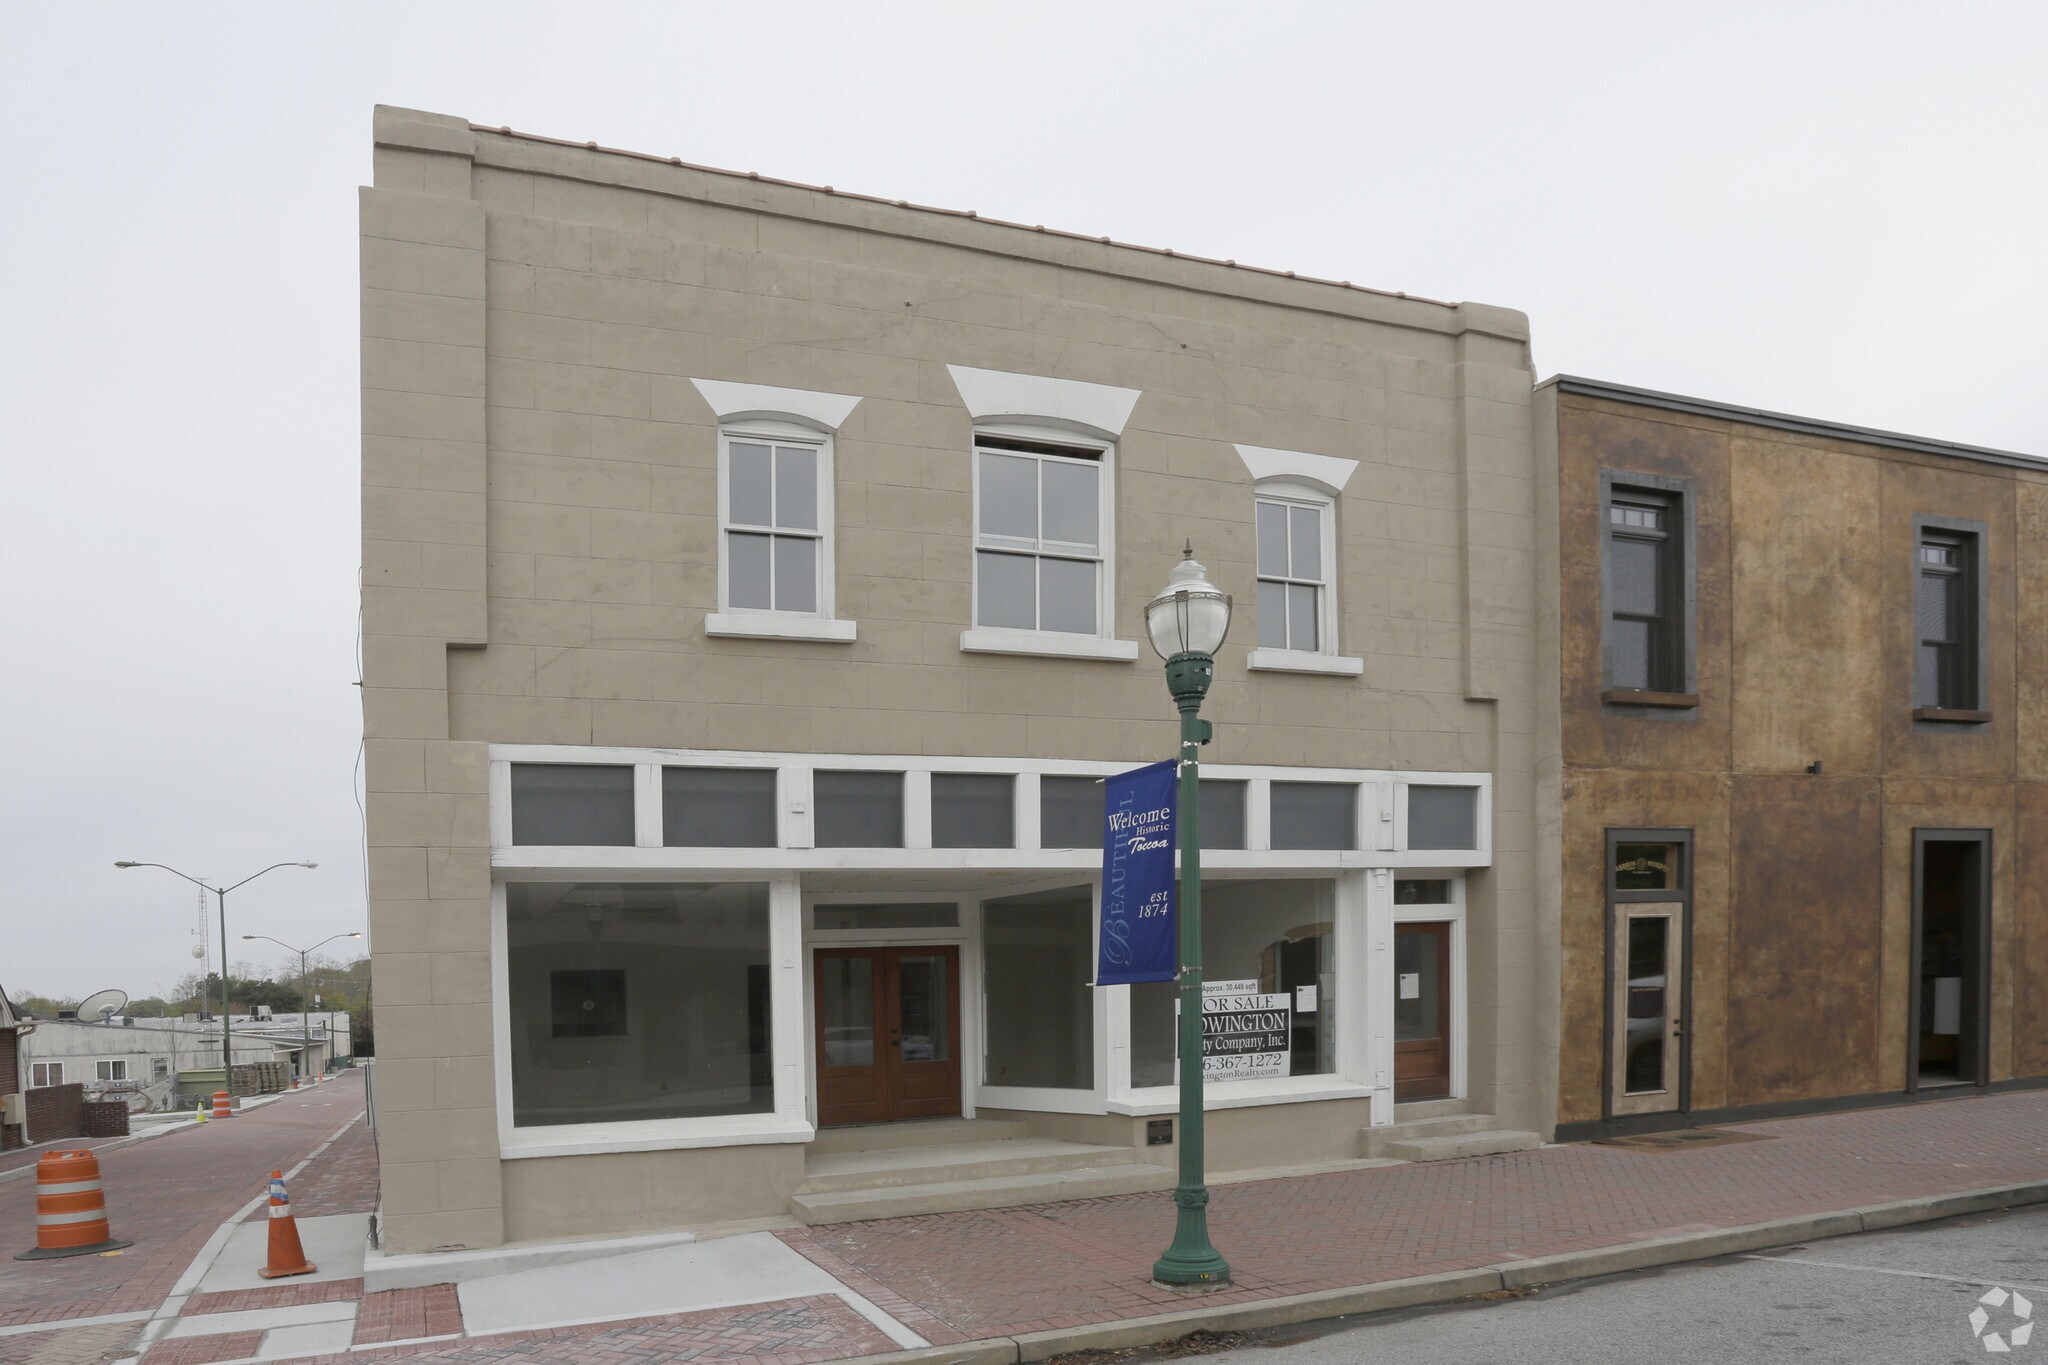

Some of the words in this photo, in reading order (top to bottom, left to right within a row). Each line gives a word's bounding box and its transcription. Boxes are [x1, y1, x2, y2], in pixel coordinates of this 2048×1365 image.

[1108, 807, 1170, 832] Welcome
[1136, 821, 1170, 836] Historic
[1128, 836, 1169, 854] Toccoa
[1150, 890, 1168, 902] est
[1139, 903, 1168, 918] 1874
[1203, 998, 1229, 1012] OR
[1234, 995, 1274, 1010] SALE
[1202, 1012, 1286, 1033] WINGTON
[1215, 1036, 1265, 1052] Company,
[1268, 1033, 1286, 1047] Inc.
[1203, 1053, 1282, 1071] 6-367-1272
